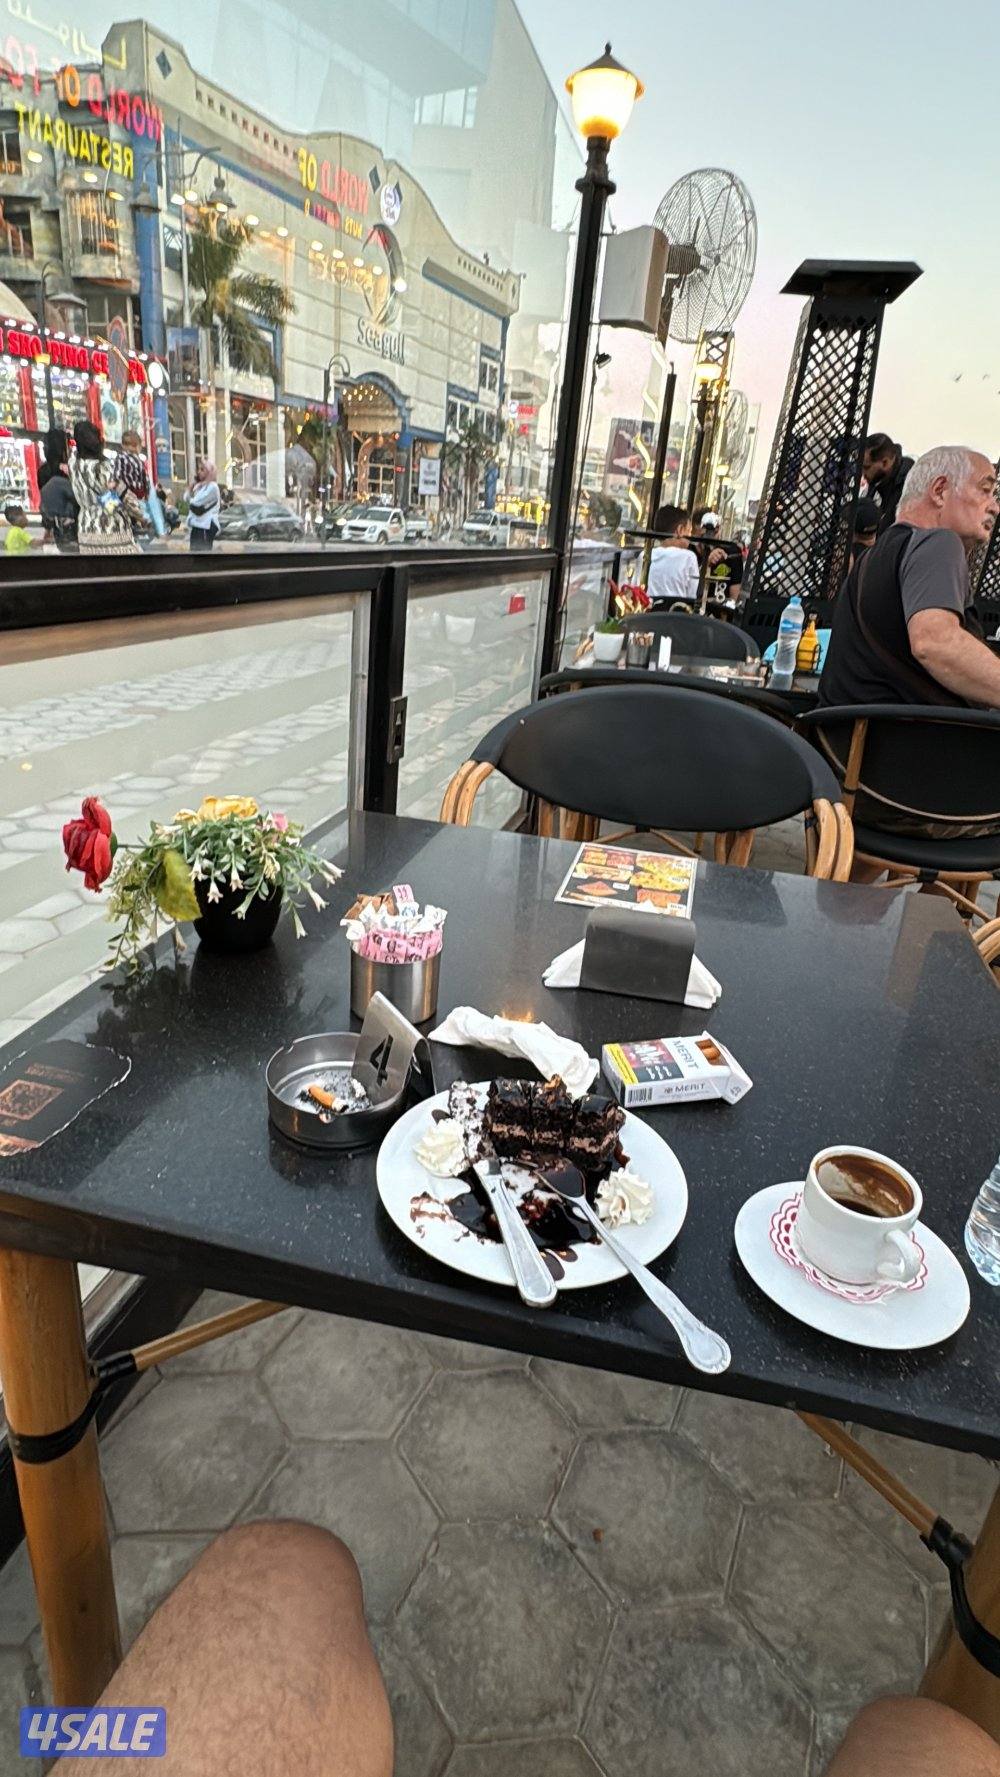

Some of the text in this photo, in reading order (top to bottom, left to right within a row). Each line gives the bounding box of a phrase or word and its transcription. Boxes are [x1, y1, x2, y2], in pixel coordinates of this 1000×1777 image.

[357, 316, 405, 366] Seagull
[369, 1034, 394, 1088] 4
[672, 1040, 700, 1069] MERIT
[674, 1083, 706, 1092] MERIT
